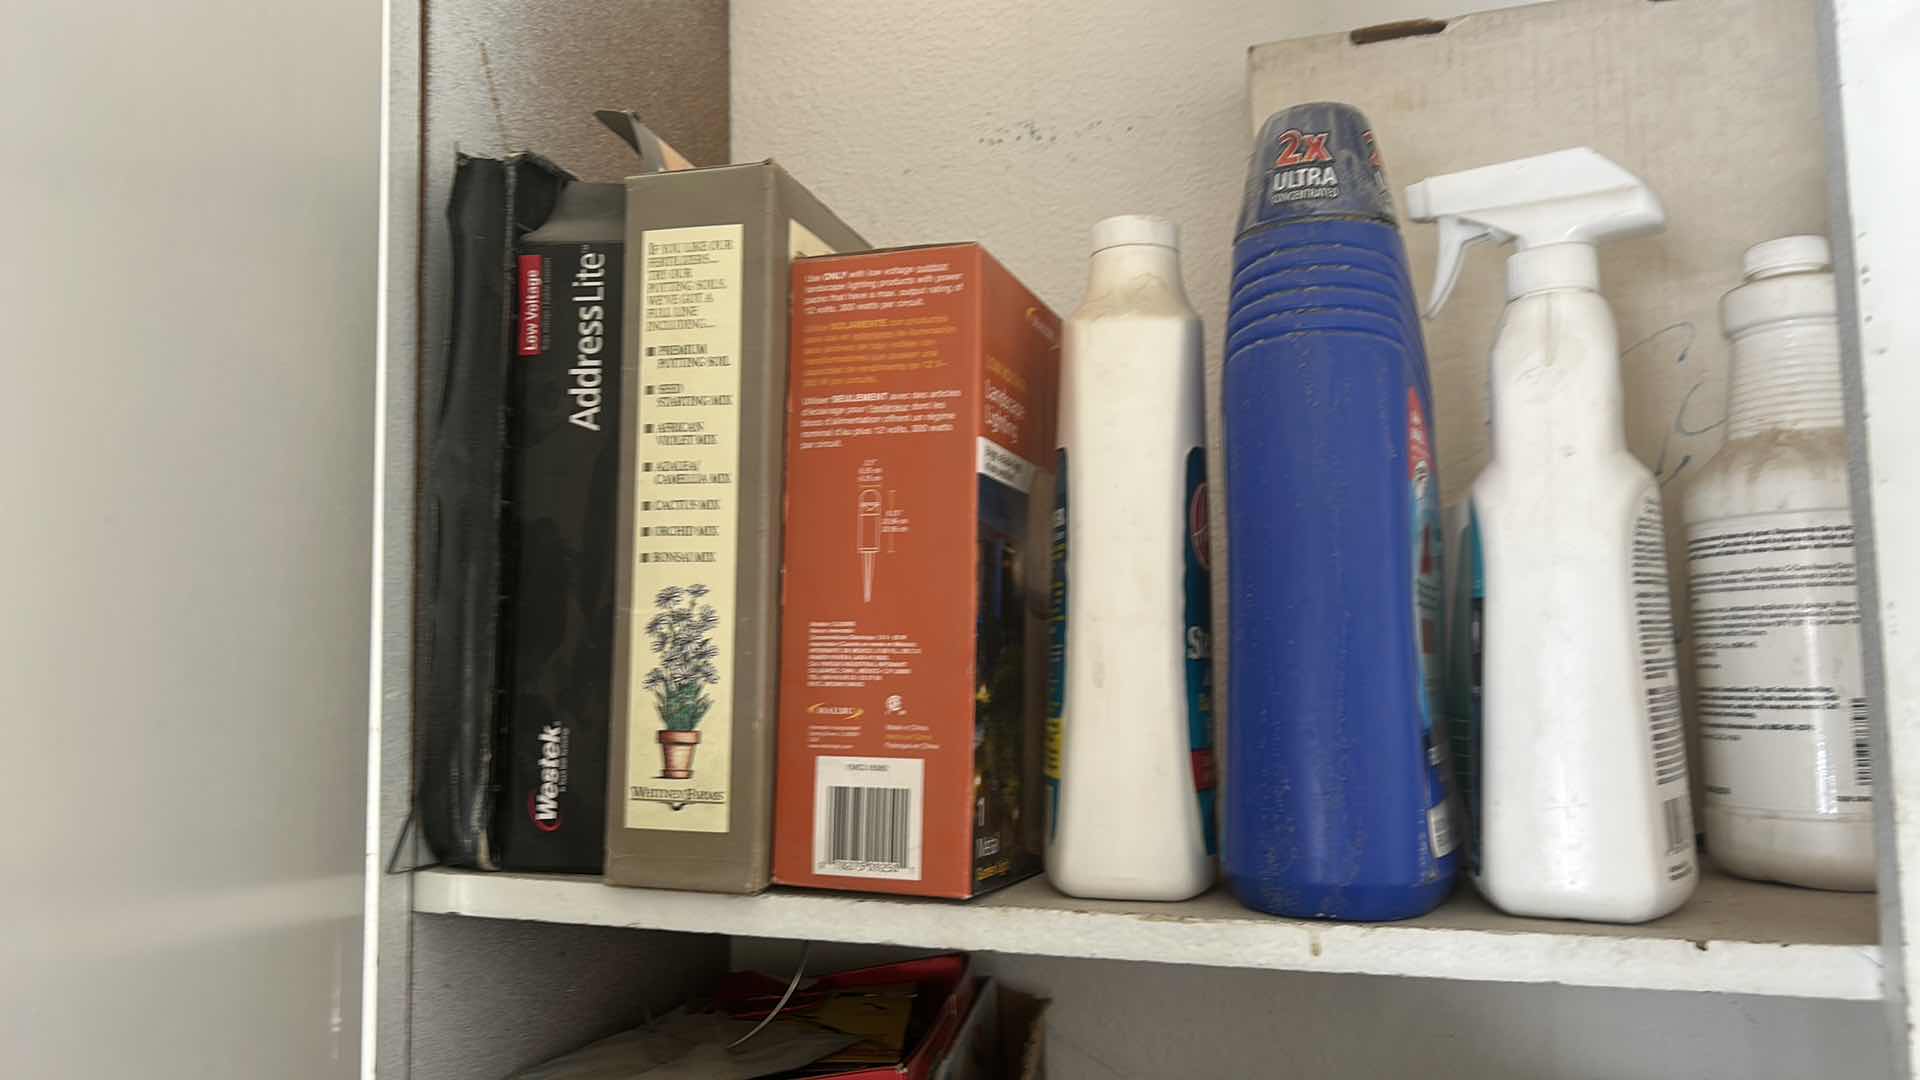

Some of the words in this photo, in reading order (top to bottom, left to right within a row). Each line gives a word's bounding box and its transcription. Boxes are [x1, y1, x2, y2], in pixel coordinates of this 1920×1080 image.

[1276, 128, 1332, 167] 2X
[1273, 166, 1338, 191] ULTRA
[823, 271, 848, 281] ONLY
[524, 270, 541, 321] Voltage
[524, 323, 538, 351] Low
[534, 725, 561, 821] Westek
